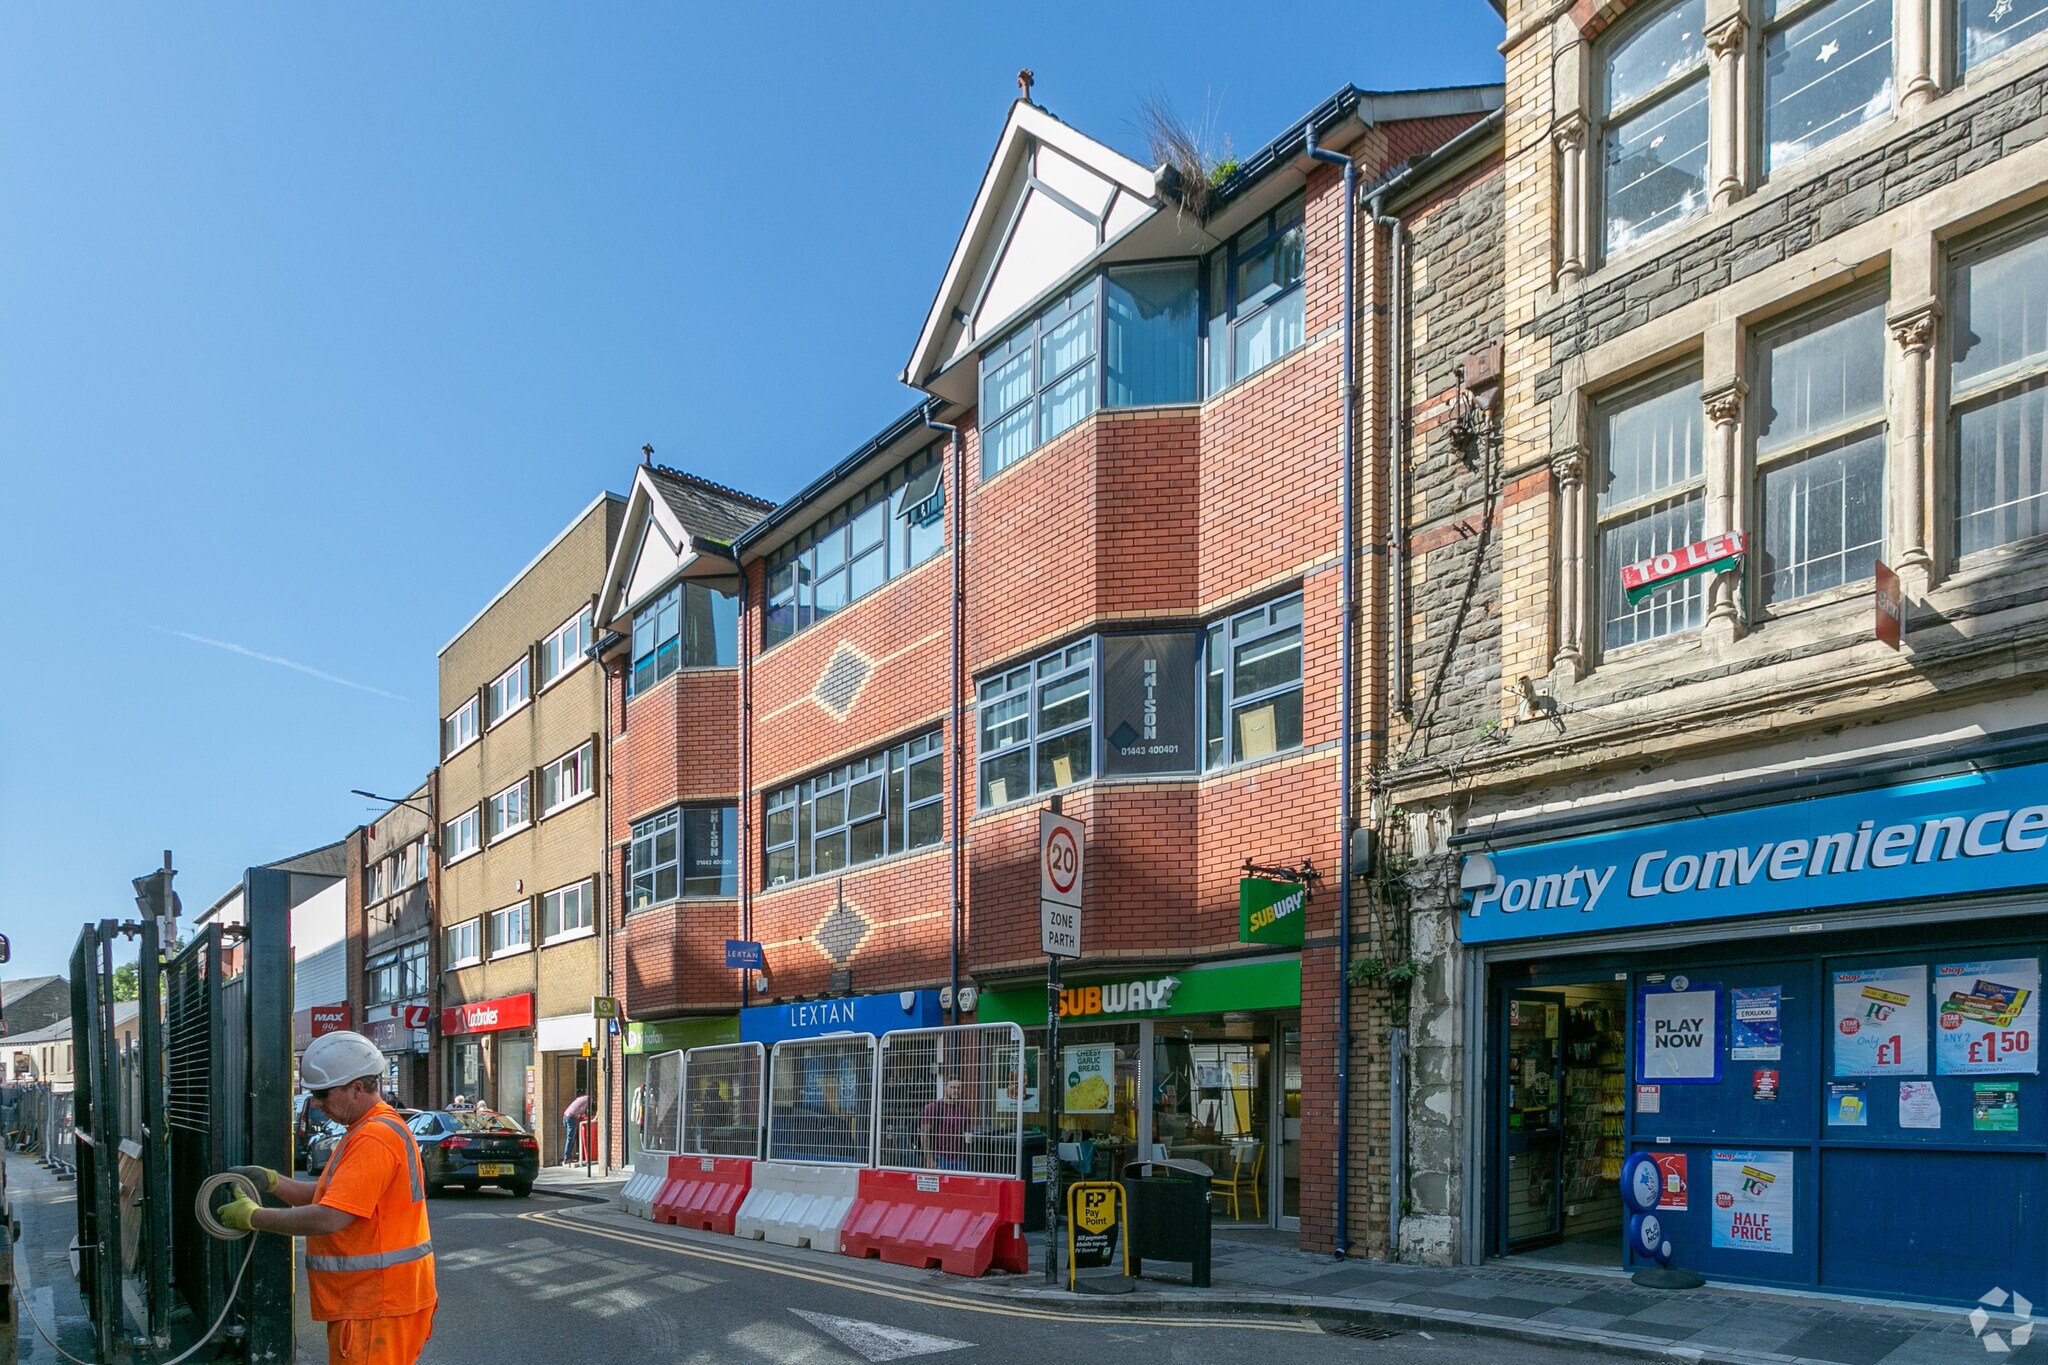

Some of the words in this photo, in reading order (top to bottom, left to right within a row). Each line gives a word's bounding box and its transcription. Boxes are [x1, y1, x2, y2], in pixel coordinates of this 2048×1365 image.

[1633, 553, 1677, 582] TO
[1686, 532, 1742, 567] LET
[1143, 659, 1156, 740] UNISON
[1121, 746, 1146, 756] 01443
[1148, 745, 1178, 755] 400401
[1051, 843, 1074, 874] 20
[1469, 863, 1617, 918] Ponty
[1629, 804, 2048, 899] Convenience
[1050, 911, 1073, 929] ZONE
[1250, 890, 1304, 933] SUBWAY
[1049, 931, 1075, 948] PARTH
[727, 949, 759, 960] LEXTAN
[1059, 976, 1181, 1017] SUBWAY
[314, 1012, 345, 1022] MAX
[467, 1007, 498, 1028] Ladbrokes
[791, 1001, 855, 1028] LEXTAN
[1865, 1002, 1891, 1021] PG
[1655, 1019, 1704, 1033] PLAY
[1655, 1034, 1704, 1048] NOW
[1857, 1035, 1880, 1049] Only
[1943, 1033, 1963, 1043] ANY
[1965, 1032, 1971, 1042] 2
[1076, 1049, 1101, 1057] CHEESY
[1877, 1035, 1902, 1065] £1
[1968, 1030, 2029, 1063] £1.50
[1077, 1056, 1101, 1064] GARLIC
[1078, 1064, 1101, 1072] BREAD.
[1741, 1177, 1764, 1197] PG
[1086, 1209, 1099, 1218] Pay
[1733, 1212, 1769, 1227] HALF
[1731, 1226, 1772, 1241] PRICE
